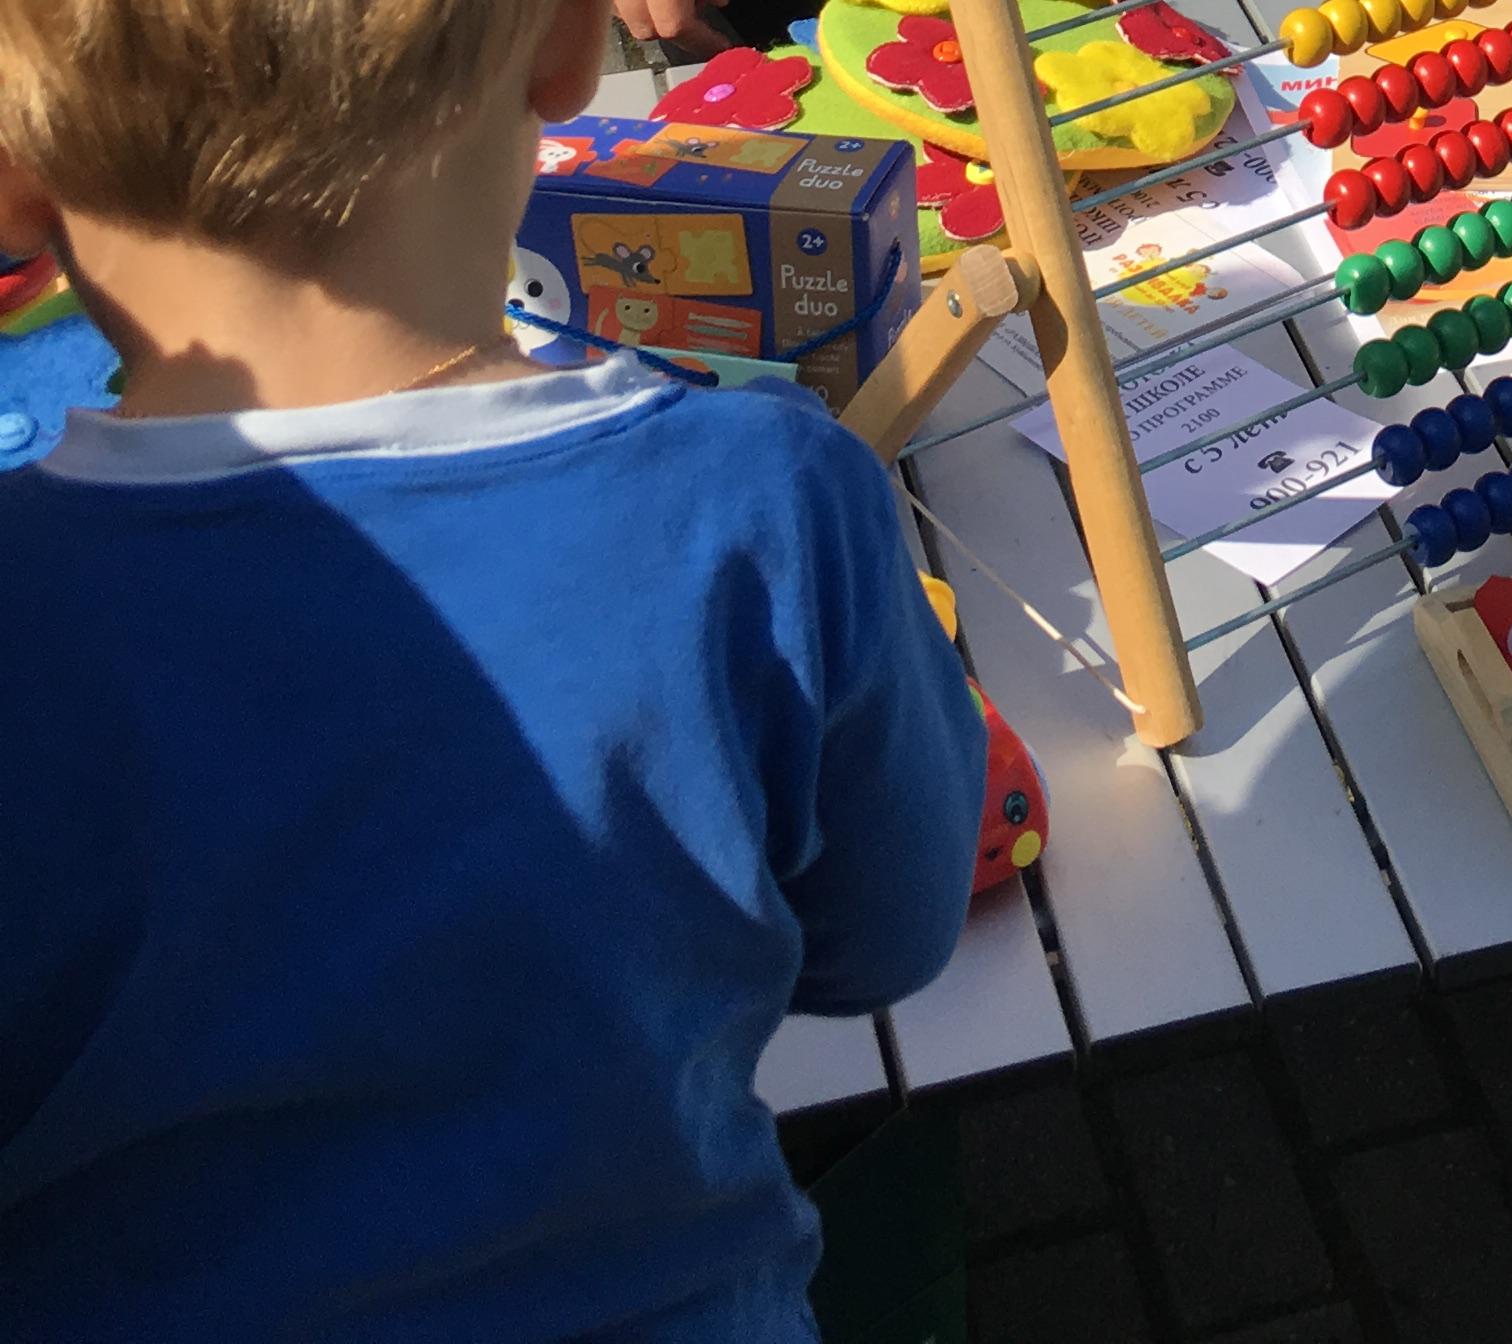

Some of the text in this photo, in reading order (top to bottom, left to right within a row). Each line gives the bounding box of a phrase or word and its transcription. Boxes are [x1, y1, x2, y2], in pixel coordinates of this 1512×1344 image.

[797, 158, 864, 177] Puzzle
[799, 174, 843, 190] duo
[801, 234, 824, 249] 2+
[780, 264, 849, 293] Puzzle
[794, 293, 838, 317] duo
[1126, 365, 1206, 413] ШКОЛЕ
[1137, 365, 1248, 433] ПРОГРАММЕ
[1181, 408, 1221, 433] 2100
[1184, 458, 1203, 474] с
